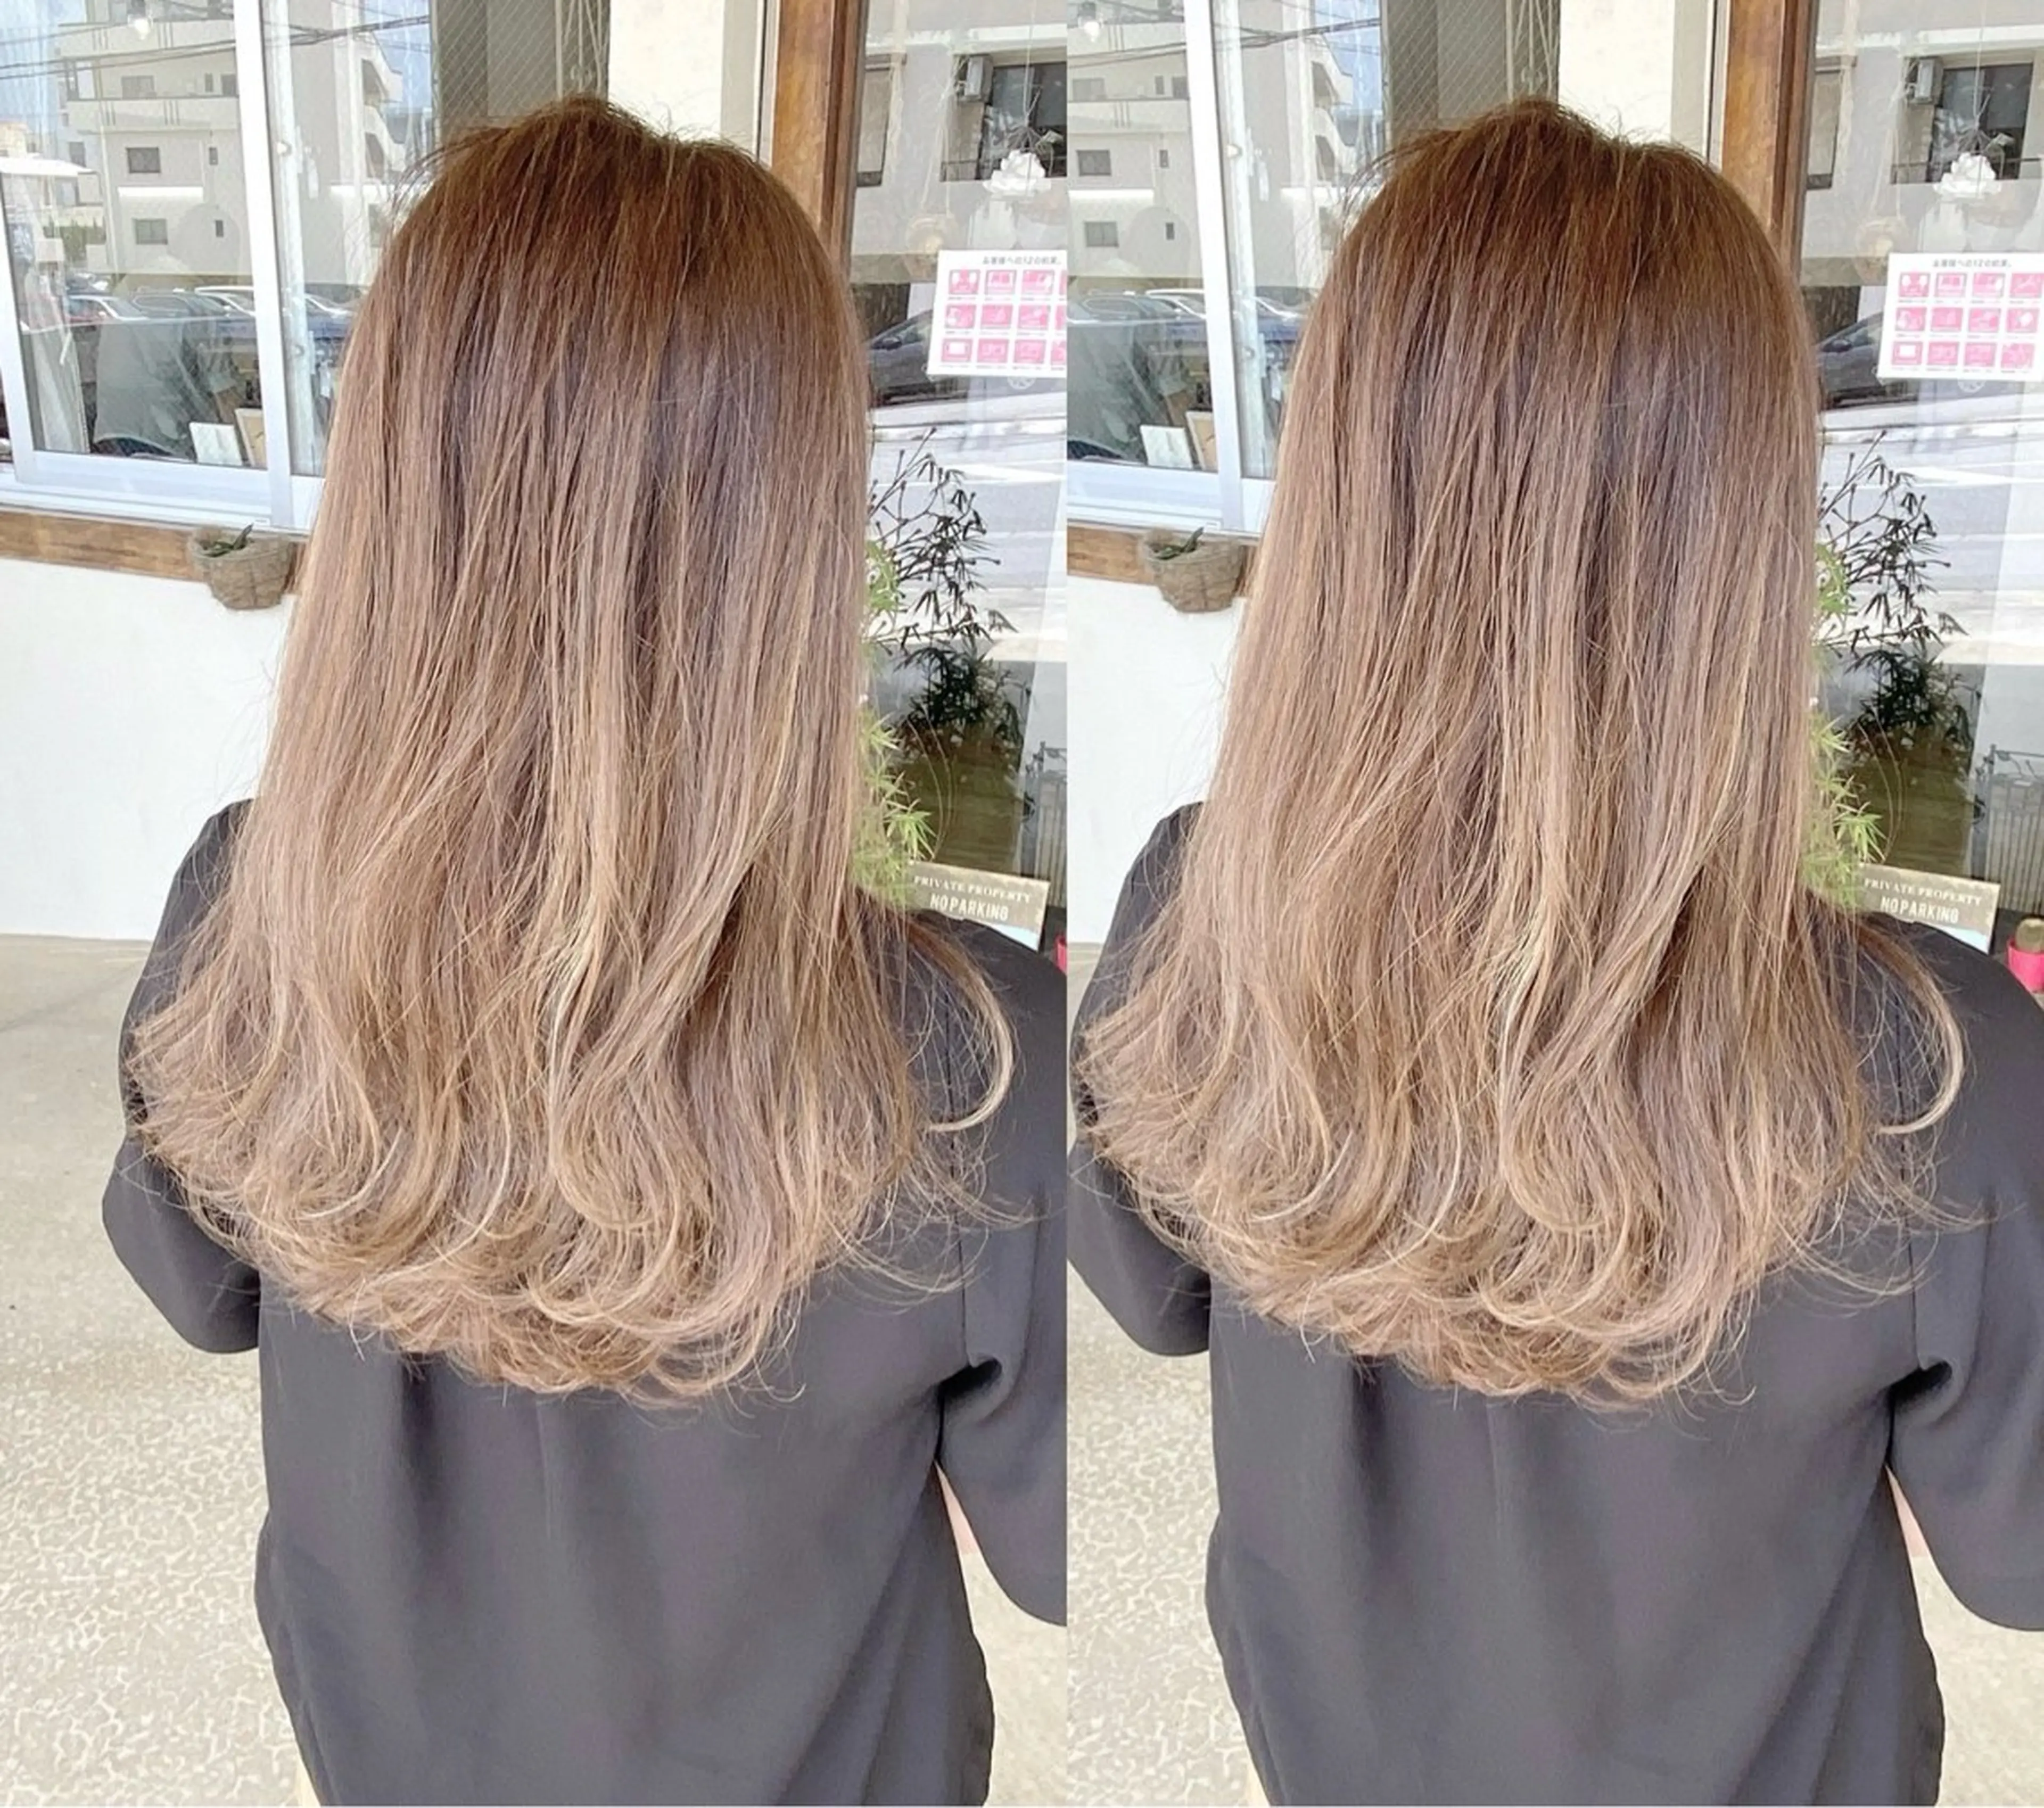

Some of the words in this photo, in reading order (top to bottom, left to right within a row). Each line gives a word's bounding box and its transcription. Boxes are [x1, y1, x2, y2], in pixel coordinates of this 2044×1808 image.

[913, 876, 965, 893] PRIVATE
[967, 886, 1031, 903] PROPERTY
[1864, 878, 1915, 895] PRIVATE
[1918, 887, 1982, 905] PROPERTY
